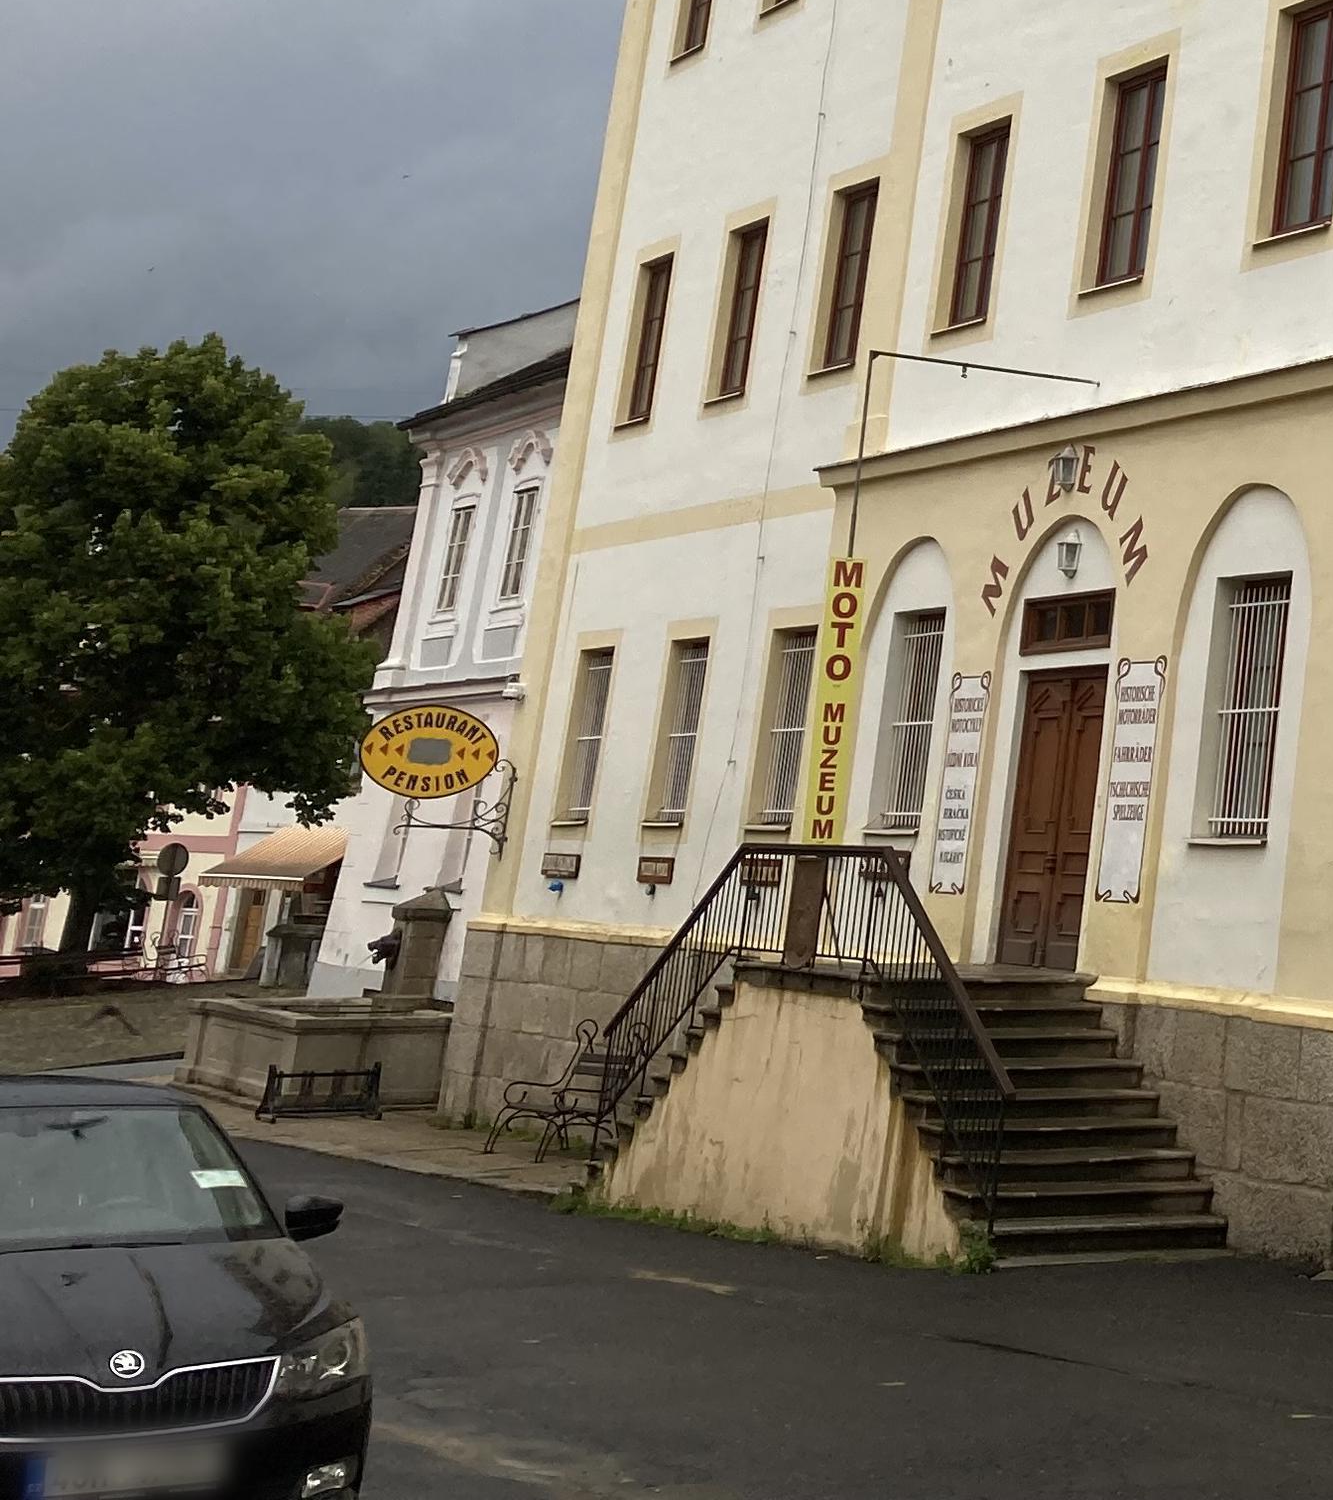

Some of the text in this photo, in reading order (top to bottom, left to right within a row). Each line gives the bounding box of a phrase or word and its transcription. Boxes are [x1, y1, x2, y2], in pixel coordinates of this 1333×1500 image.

[825, 560, 863, 681] MOTO
[378, 712, 487, 745] RESTAURANT
[381, 765, 469, 792] PENSION
[811, 702, 845, 840] MUZEUM
